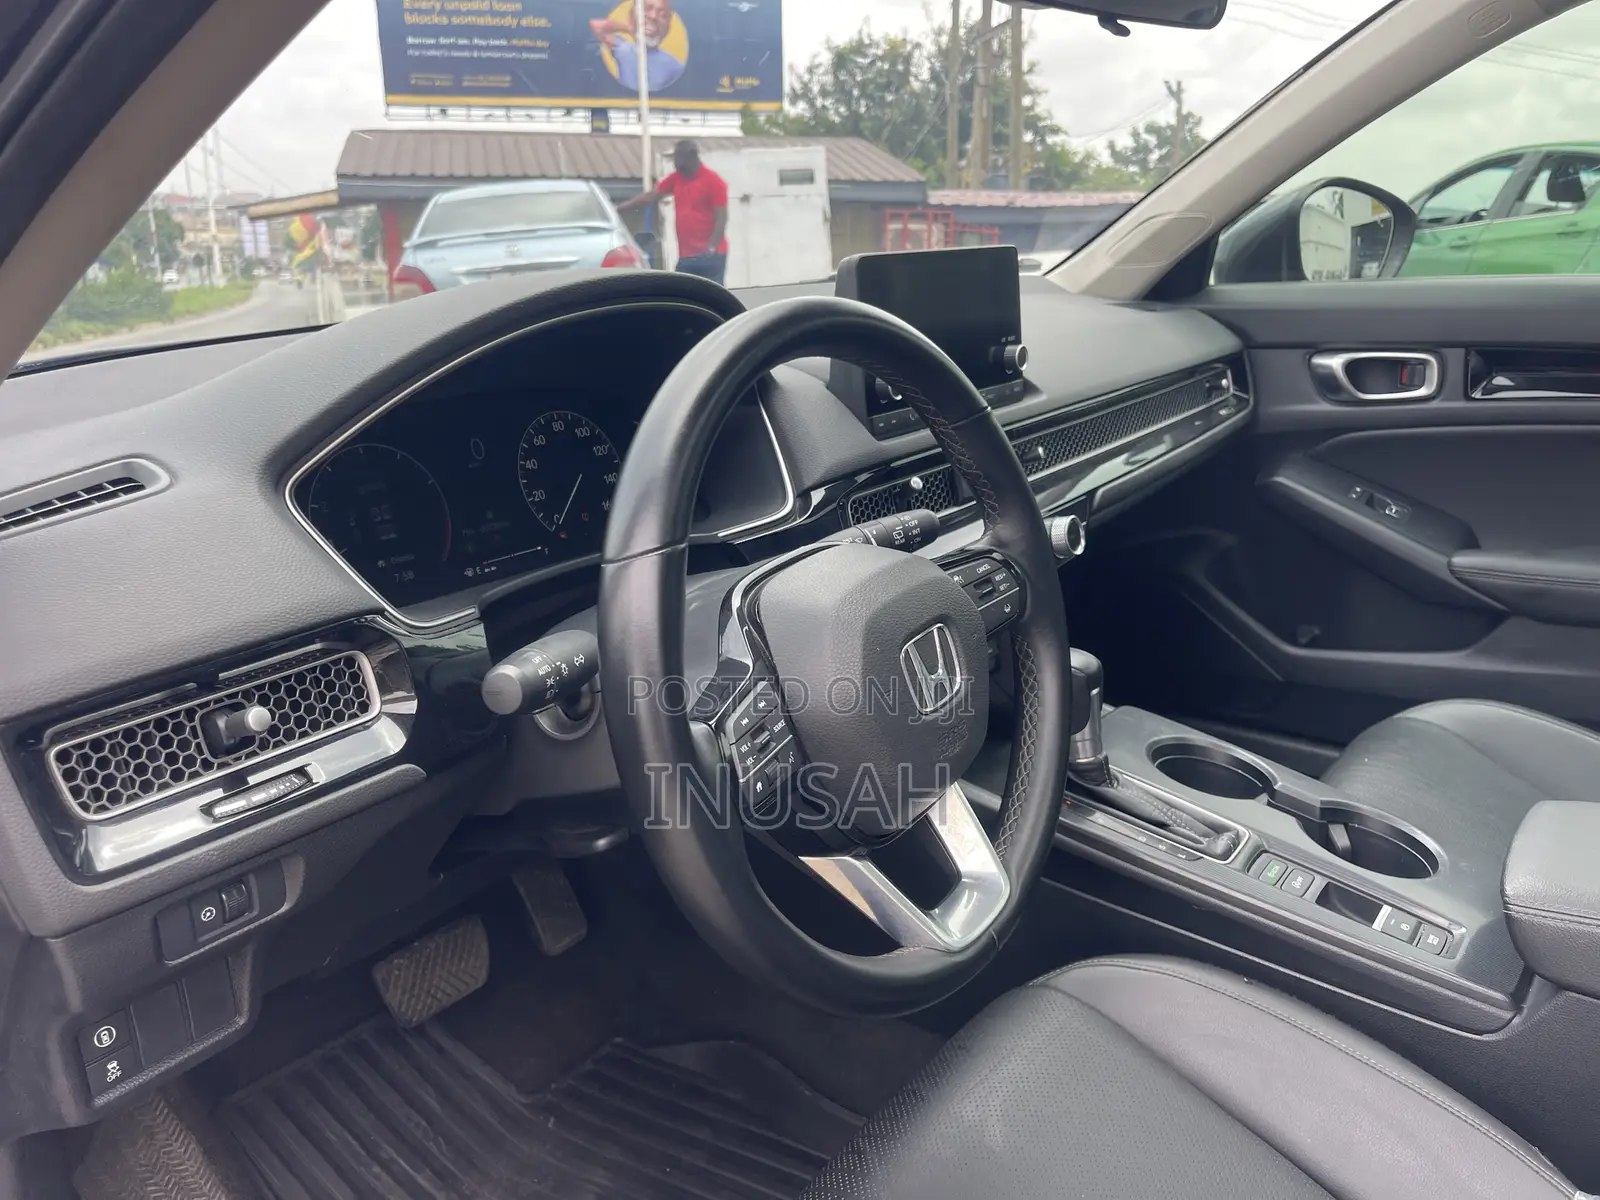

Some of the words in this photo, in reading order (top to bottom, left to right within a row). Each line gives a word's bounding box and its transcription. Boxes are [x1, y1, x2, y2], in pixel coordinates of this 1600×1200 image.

[451, 14, 519, 29] somebody
[552, 420, 565, 432] 80
[575, 427, 591, 438] 100
[533, 435, 546, 446] 60
[593, 445, 608, 456] 120
[525, 459, 538, 470] 40
[532, 489, 546, 501] 20
[532, 655, 543, 664] OFF
[538, 665, 551, 676] AUTO
[106, 1070, 122, 1082] OFF
